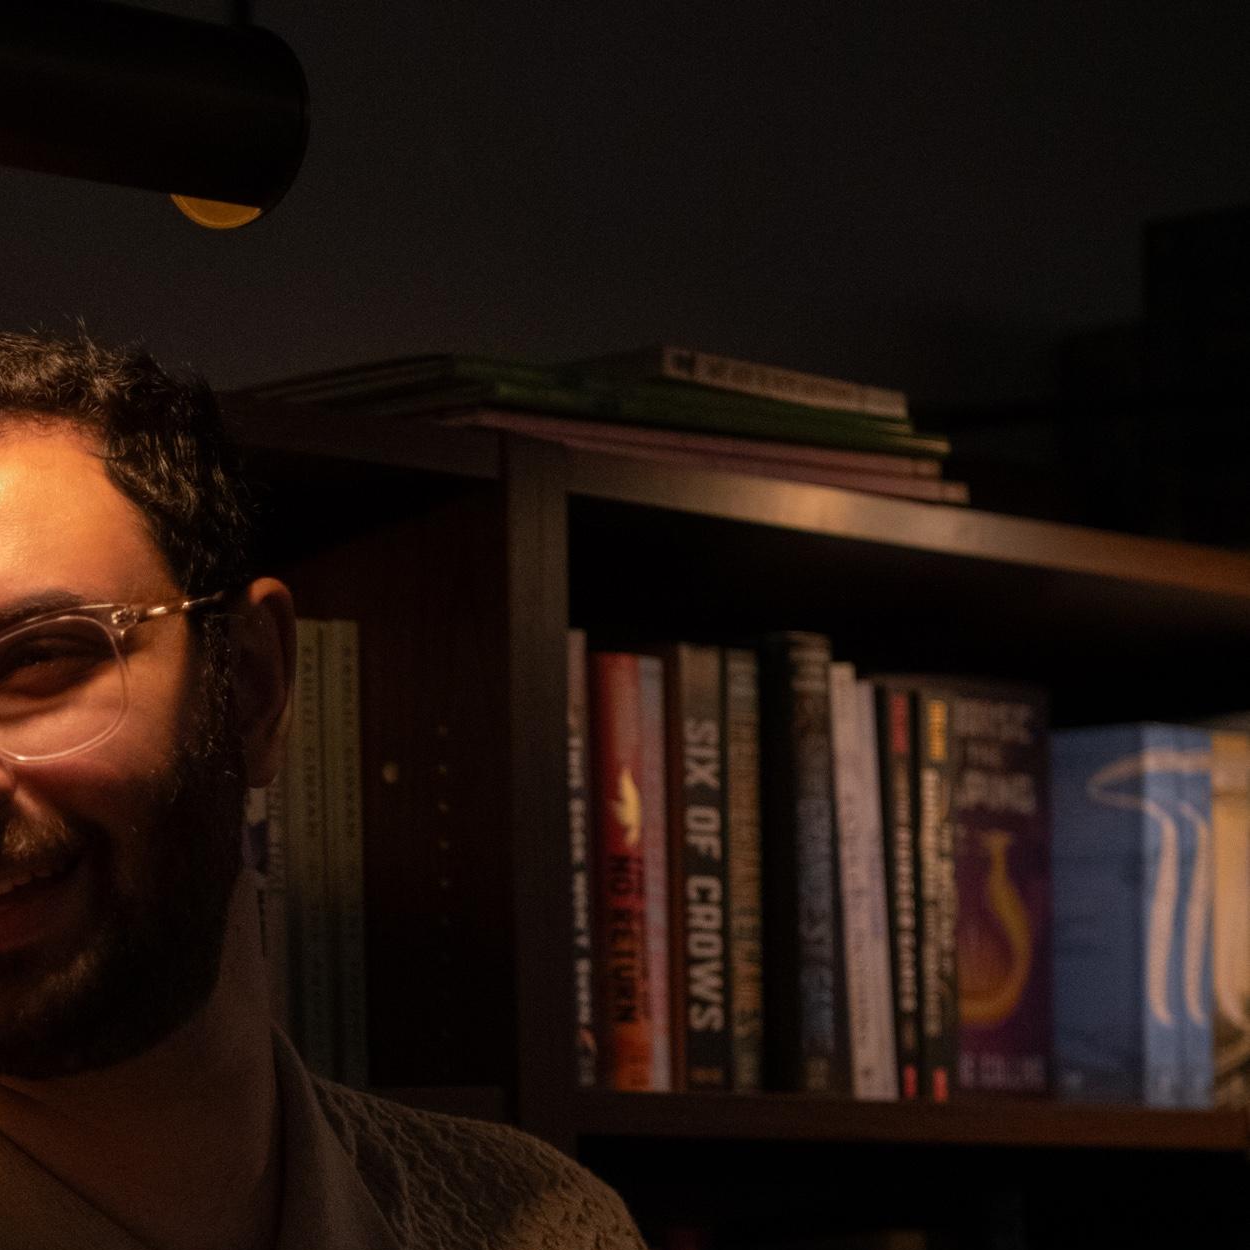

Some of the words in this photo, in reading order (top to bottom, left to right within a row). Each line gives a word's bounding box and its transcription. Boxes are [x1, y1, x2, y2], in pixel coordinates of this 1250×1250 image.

[682, 718, 722, 788] SIX
[569, 799, 585, 865] BOOK
[685, 803, 723, 863] OF
[610, 854, 636, 895] NO
[613, 907, 638, 1023] RETURN
[686, 873, 726, 1034] CROWS
